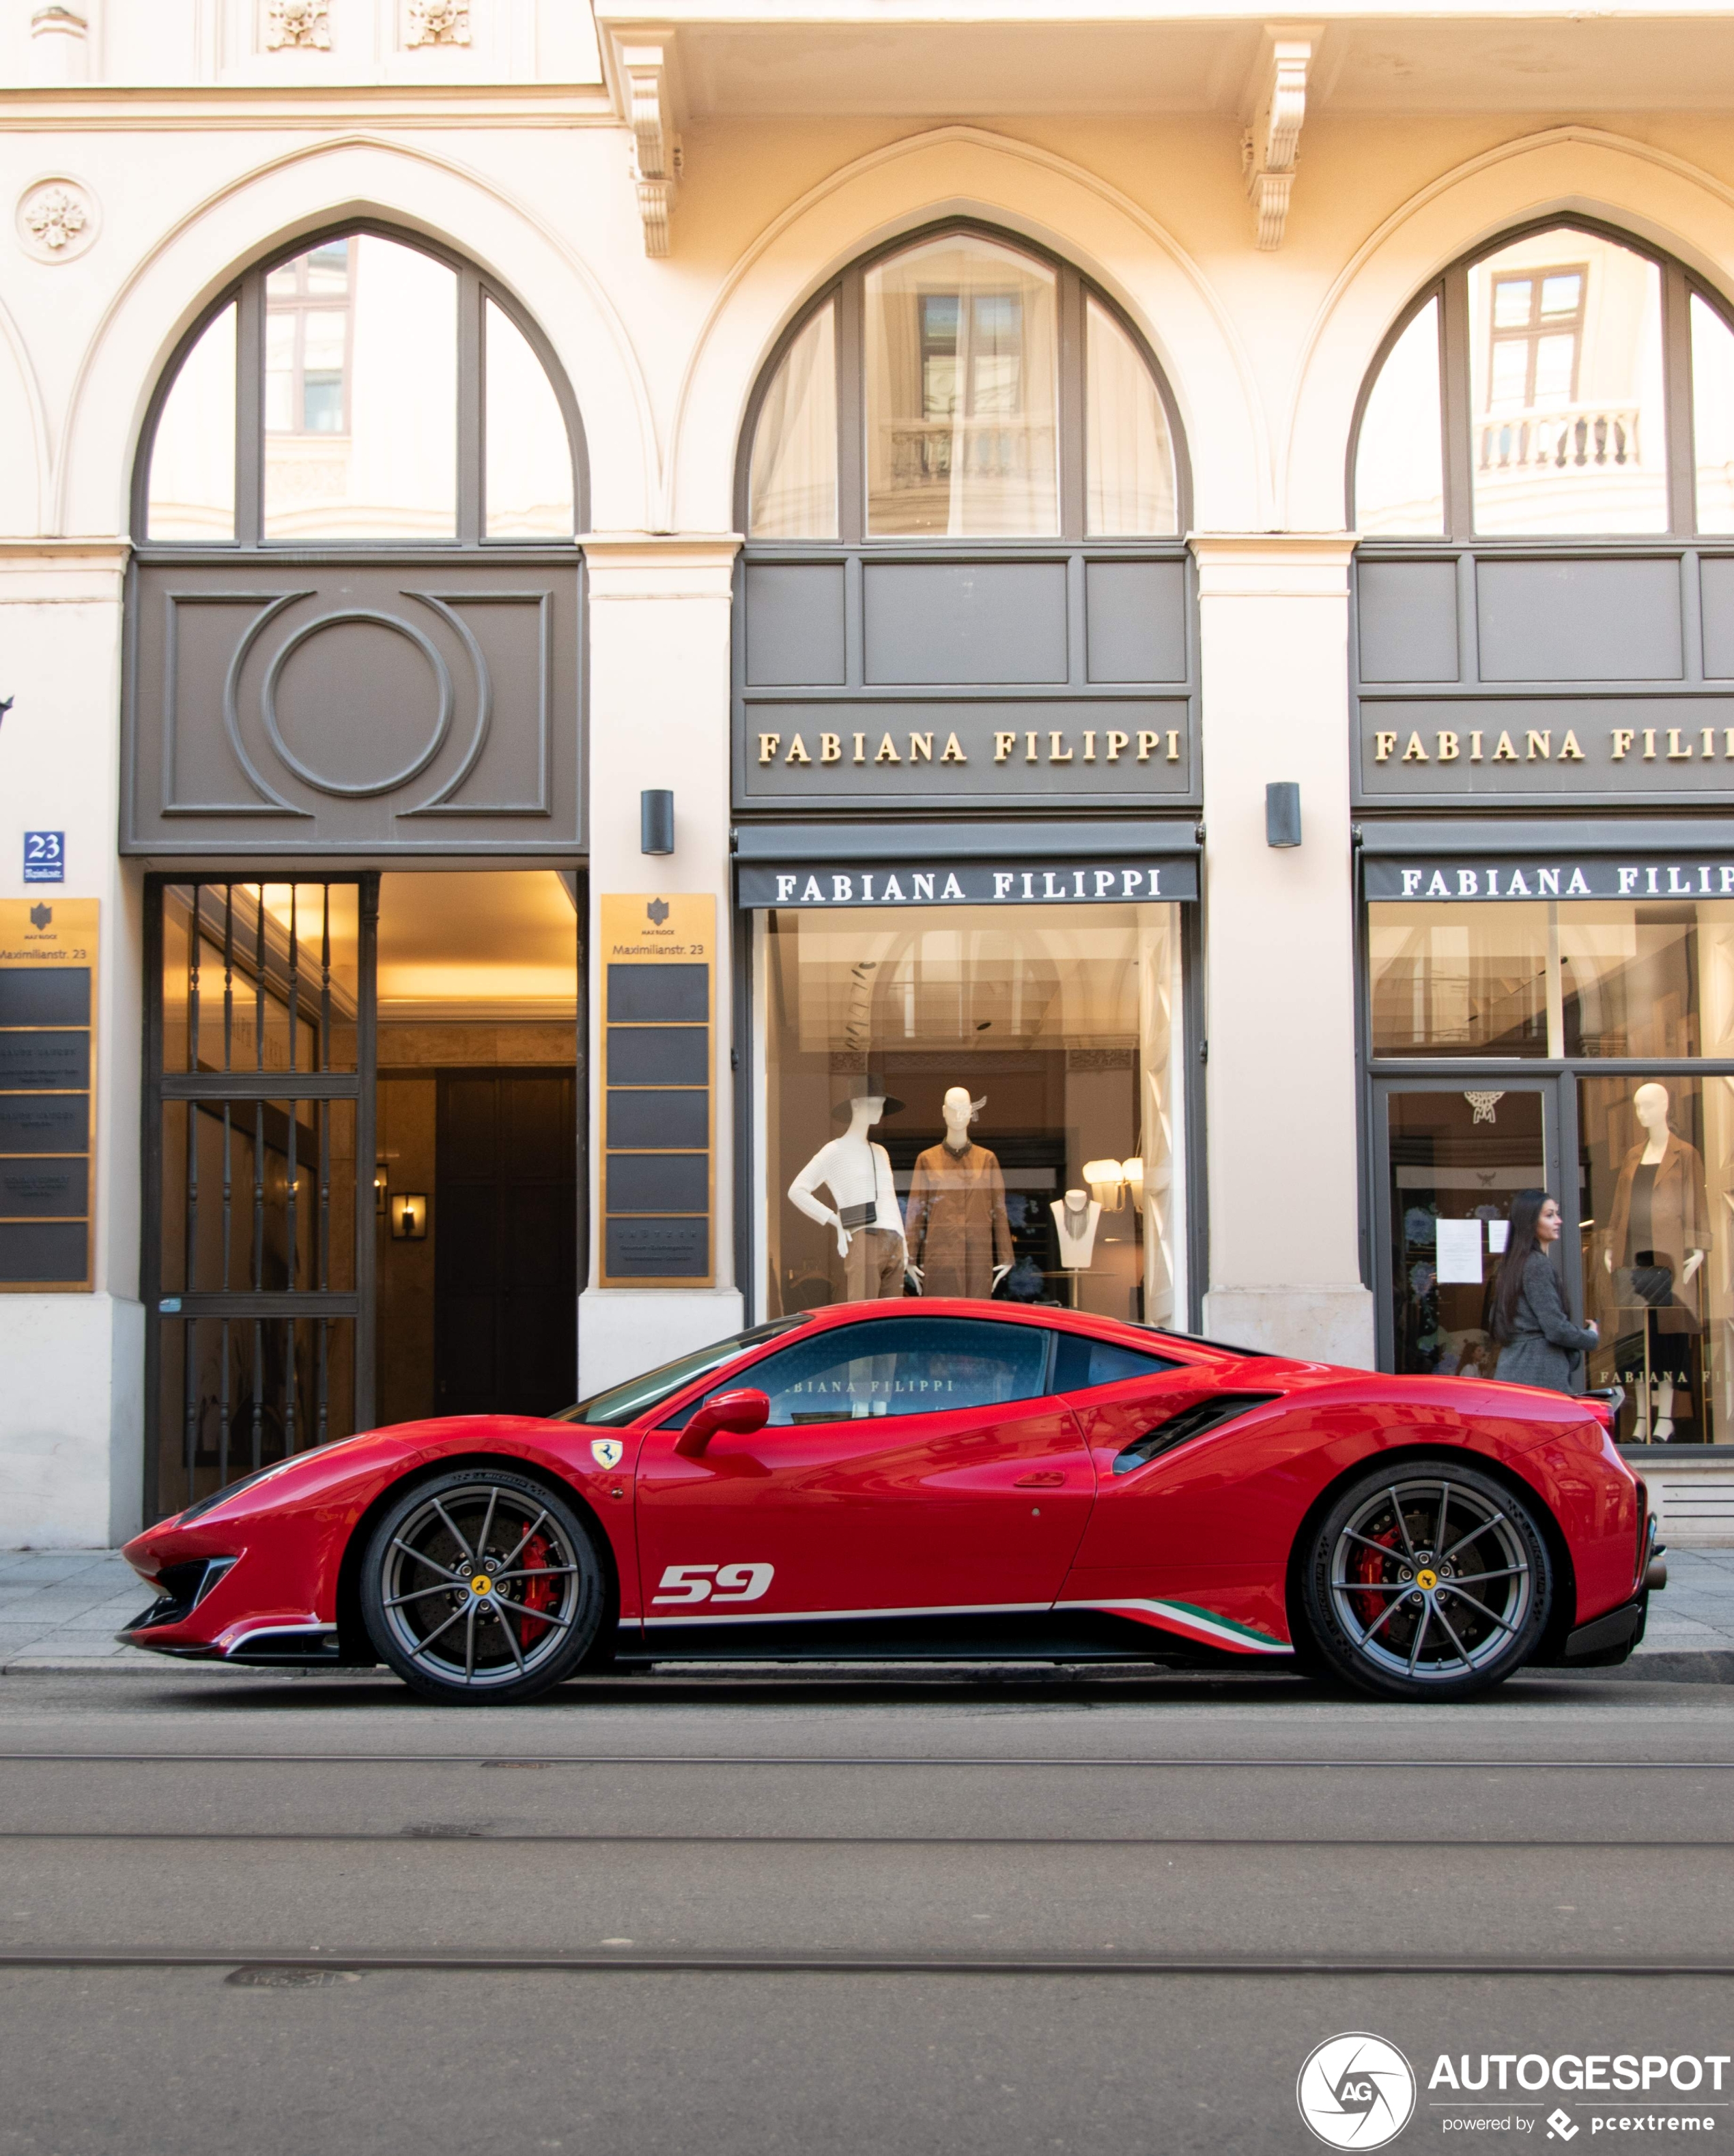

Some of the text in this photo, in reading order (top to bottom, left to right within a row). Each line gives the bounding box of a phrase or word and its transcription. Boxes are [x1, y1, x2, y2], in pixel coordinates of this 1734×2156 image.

[758, 730, 1180, 762] FABIANA FILIPPI
[1375, 730, 1586, 761] FABIANA
[29, 834, 60, 859] 23
[776, 869, 1161, 902] FABIANA FILIPPI
[1401, 867, 1591, 896] FABIANA
[73, 949, 87, 960] 23
[612, 945, 704, 955] Maximilianstr. 23
[785, 1380, 953, 1393] BIANA FILIPPI
[1600, 1370, 1688, 1383] FABIANA
[485, 1473, 528, 1488] MICHELIN
[1529, 1537, 1546, 1594] MICHELIN
[651, 1563, 776, 1605] 59
[1316, 1564, 1332, 1622] MICHELIN
